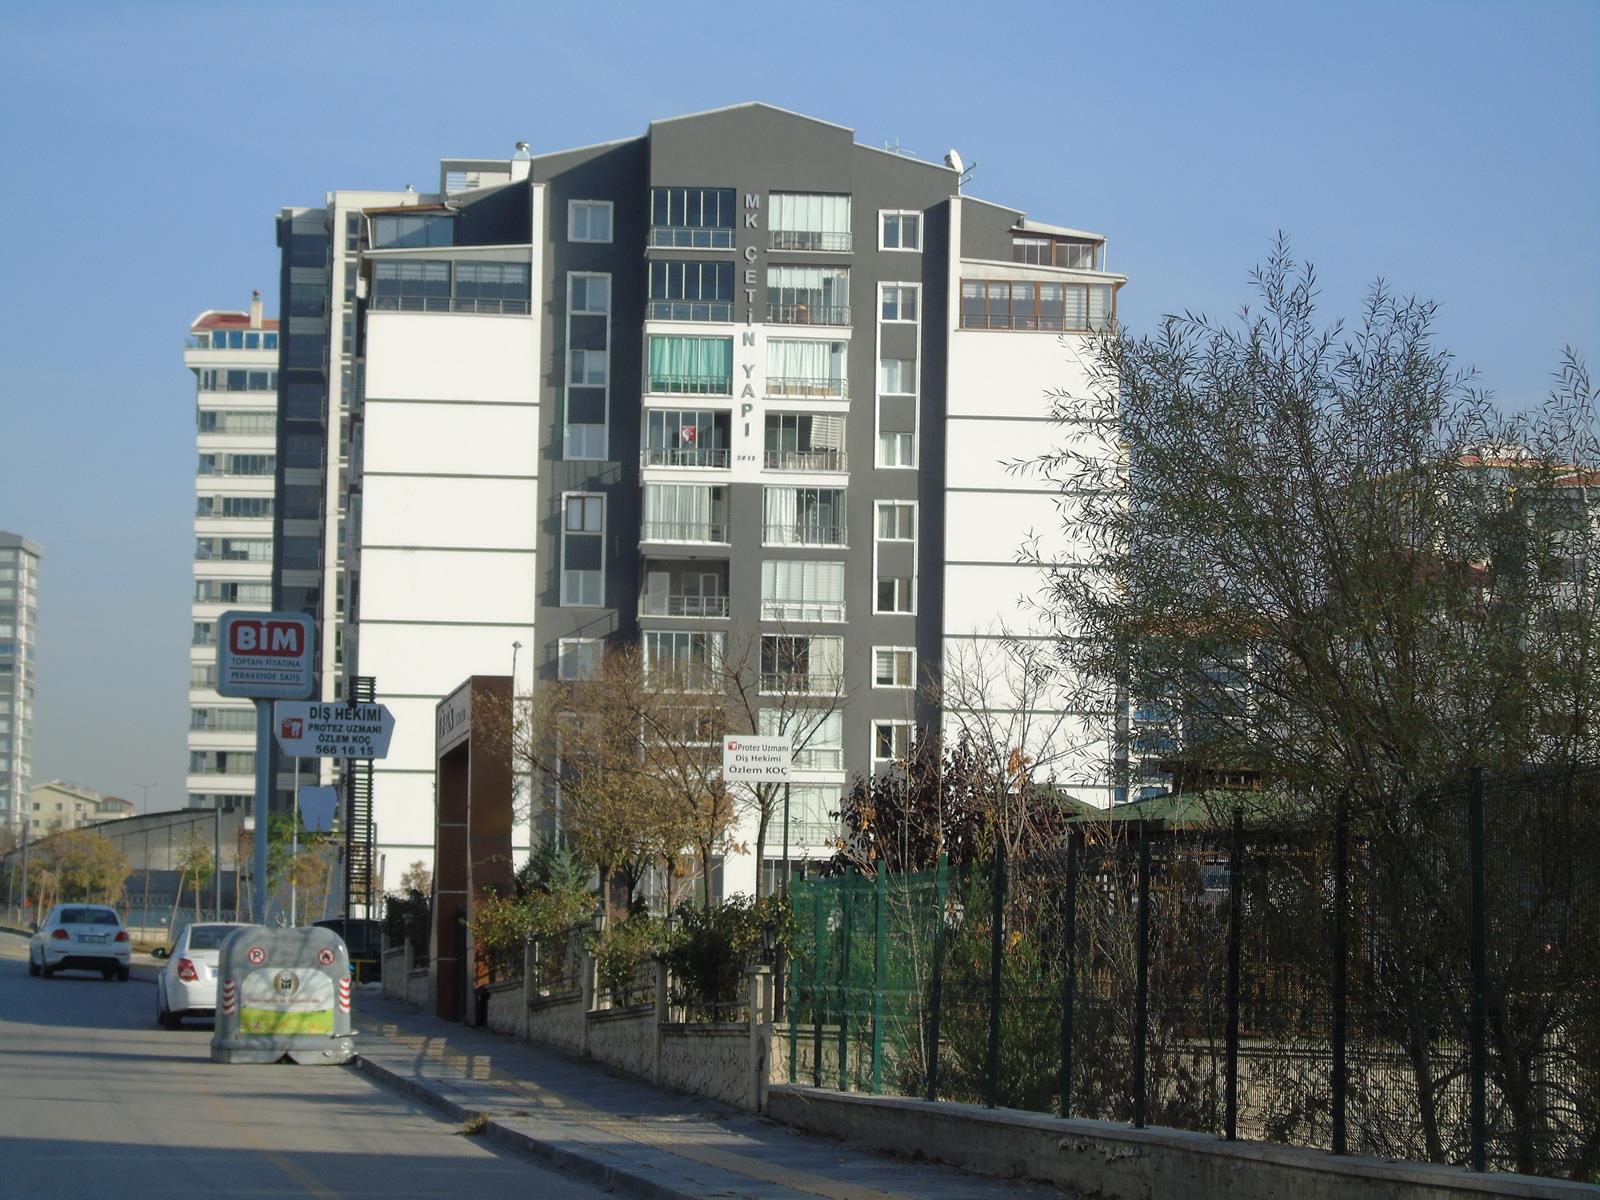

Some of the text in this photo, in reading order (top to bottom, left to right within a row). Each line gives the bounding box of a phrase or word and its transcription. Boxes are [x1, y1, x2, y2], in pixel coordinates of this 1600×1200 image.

[741, 194, 760, 437] MK ÇETİN YAPI
[231, 657, 263, 666] TOPTAN
[231, 671, 276, 680] PERAKENDE
[309, 704, 382, 723] DİŞ HEKİMİ
[308, 723, 382, 734] PROTEZ UZMANI
[318, 734, 371, 745] ÖZLEM KOÇ
[341, 746, 355, 755] 16
[360, 746, 374, 755] 15
[737, 743, 760, 752] Protez
[751, 754, 782, 762] Hekimi
[729, 764, 788, 775] Özlem KOÇ
